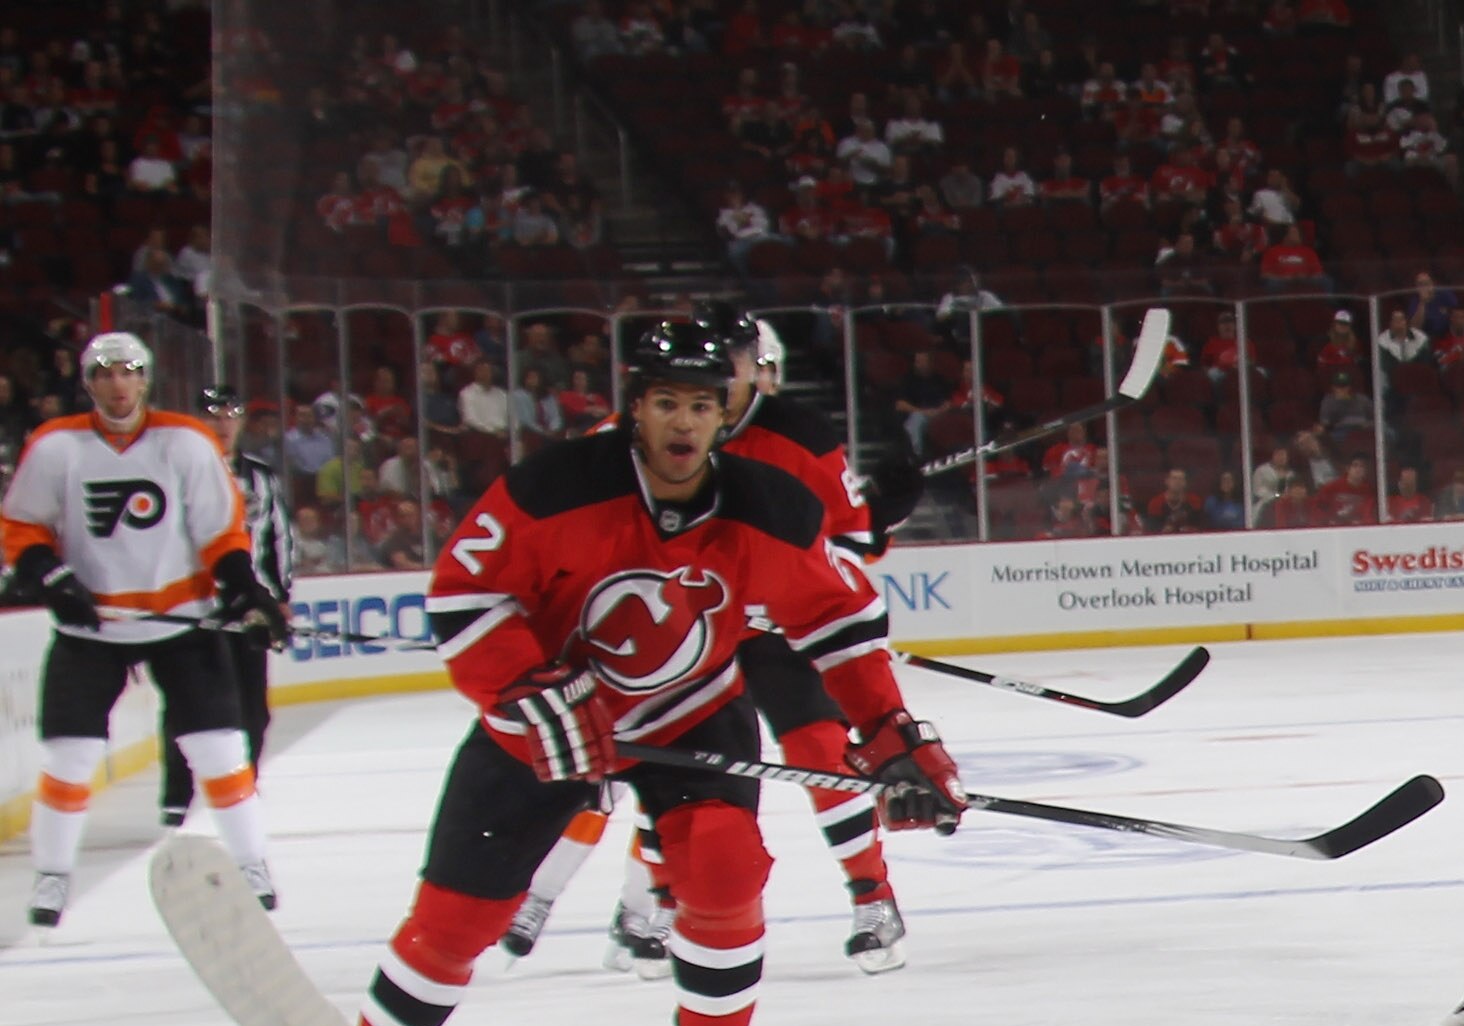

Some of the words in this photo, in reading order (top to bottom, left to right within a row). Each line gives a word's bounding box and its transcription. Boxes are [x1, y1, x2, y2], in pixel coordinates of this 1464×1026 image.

[450, 512, 505, 576] 2
[991, 562, 1112, 583] Morristown
[1120, 555, 1222, 578] Memorial
[1230, 551, 1318, 575] Hospital
[1059, 588, 1156, 610] Overlook
[1165, 583, 1252, 609] Hospital
[289, 593, 433, 661] GEICO
[725, 762, 886, 795] WARRI
